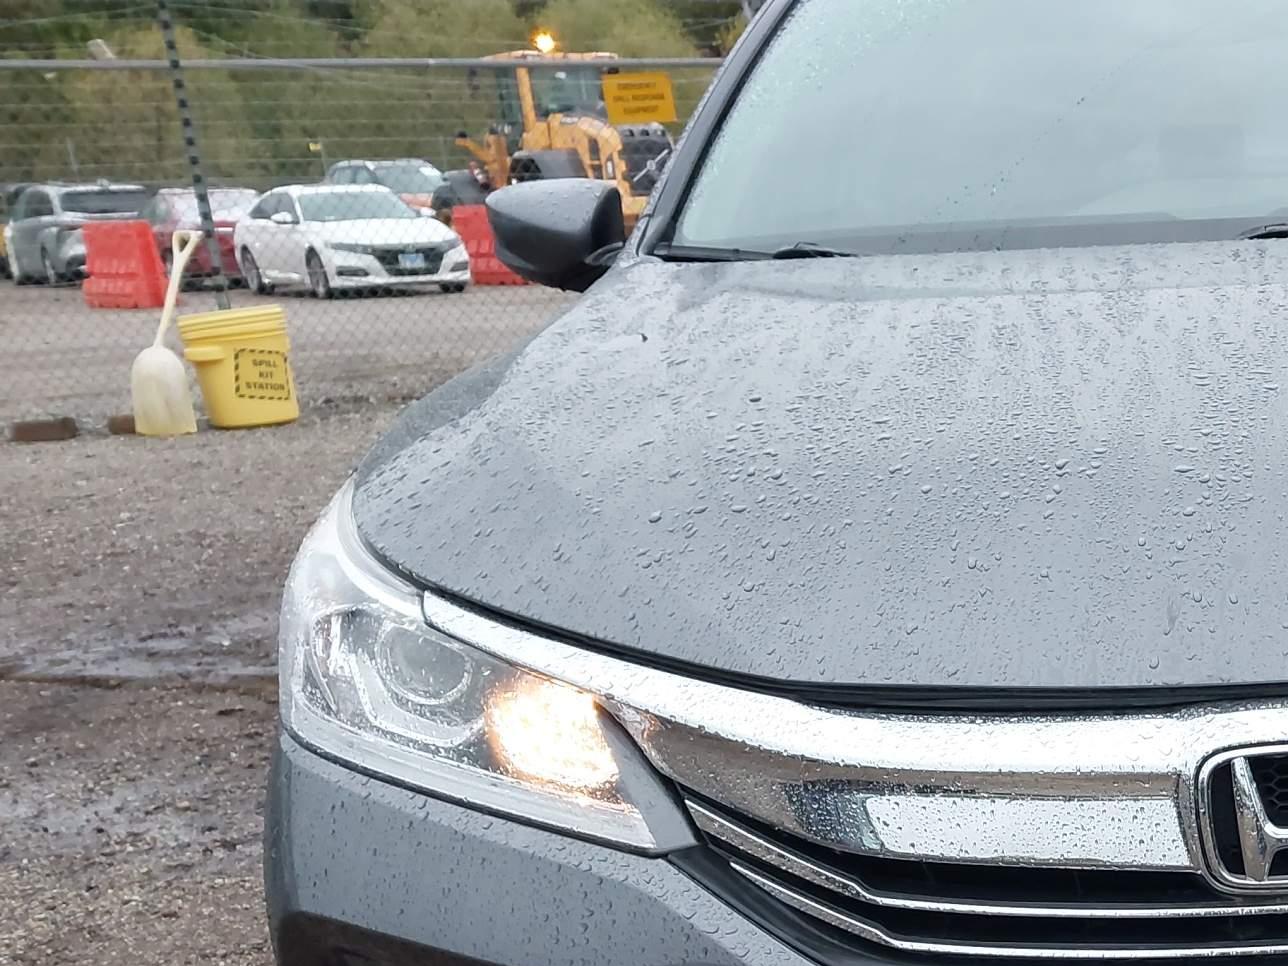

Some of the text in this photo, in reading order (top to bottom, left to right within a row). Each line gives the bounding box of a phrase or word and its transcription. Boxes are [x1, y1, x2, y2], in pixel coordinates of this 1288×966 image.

[252, 359, 277, 368] SPILL
[259, 371, 273, 379] KIT
[245, 382, 285, 390] STATION
